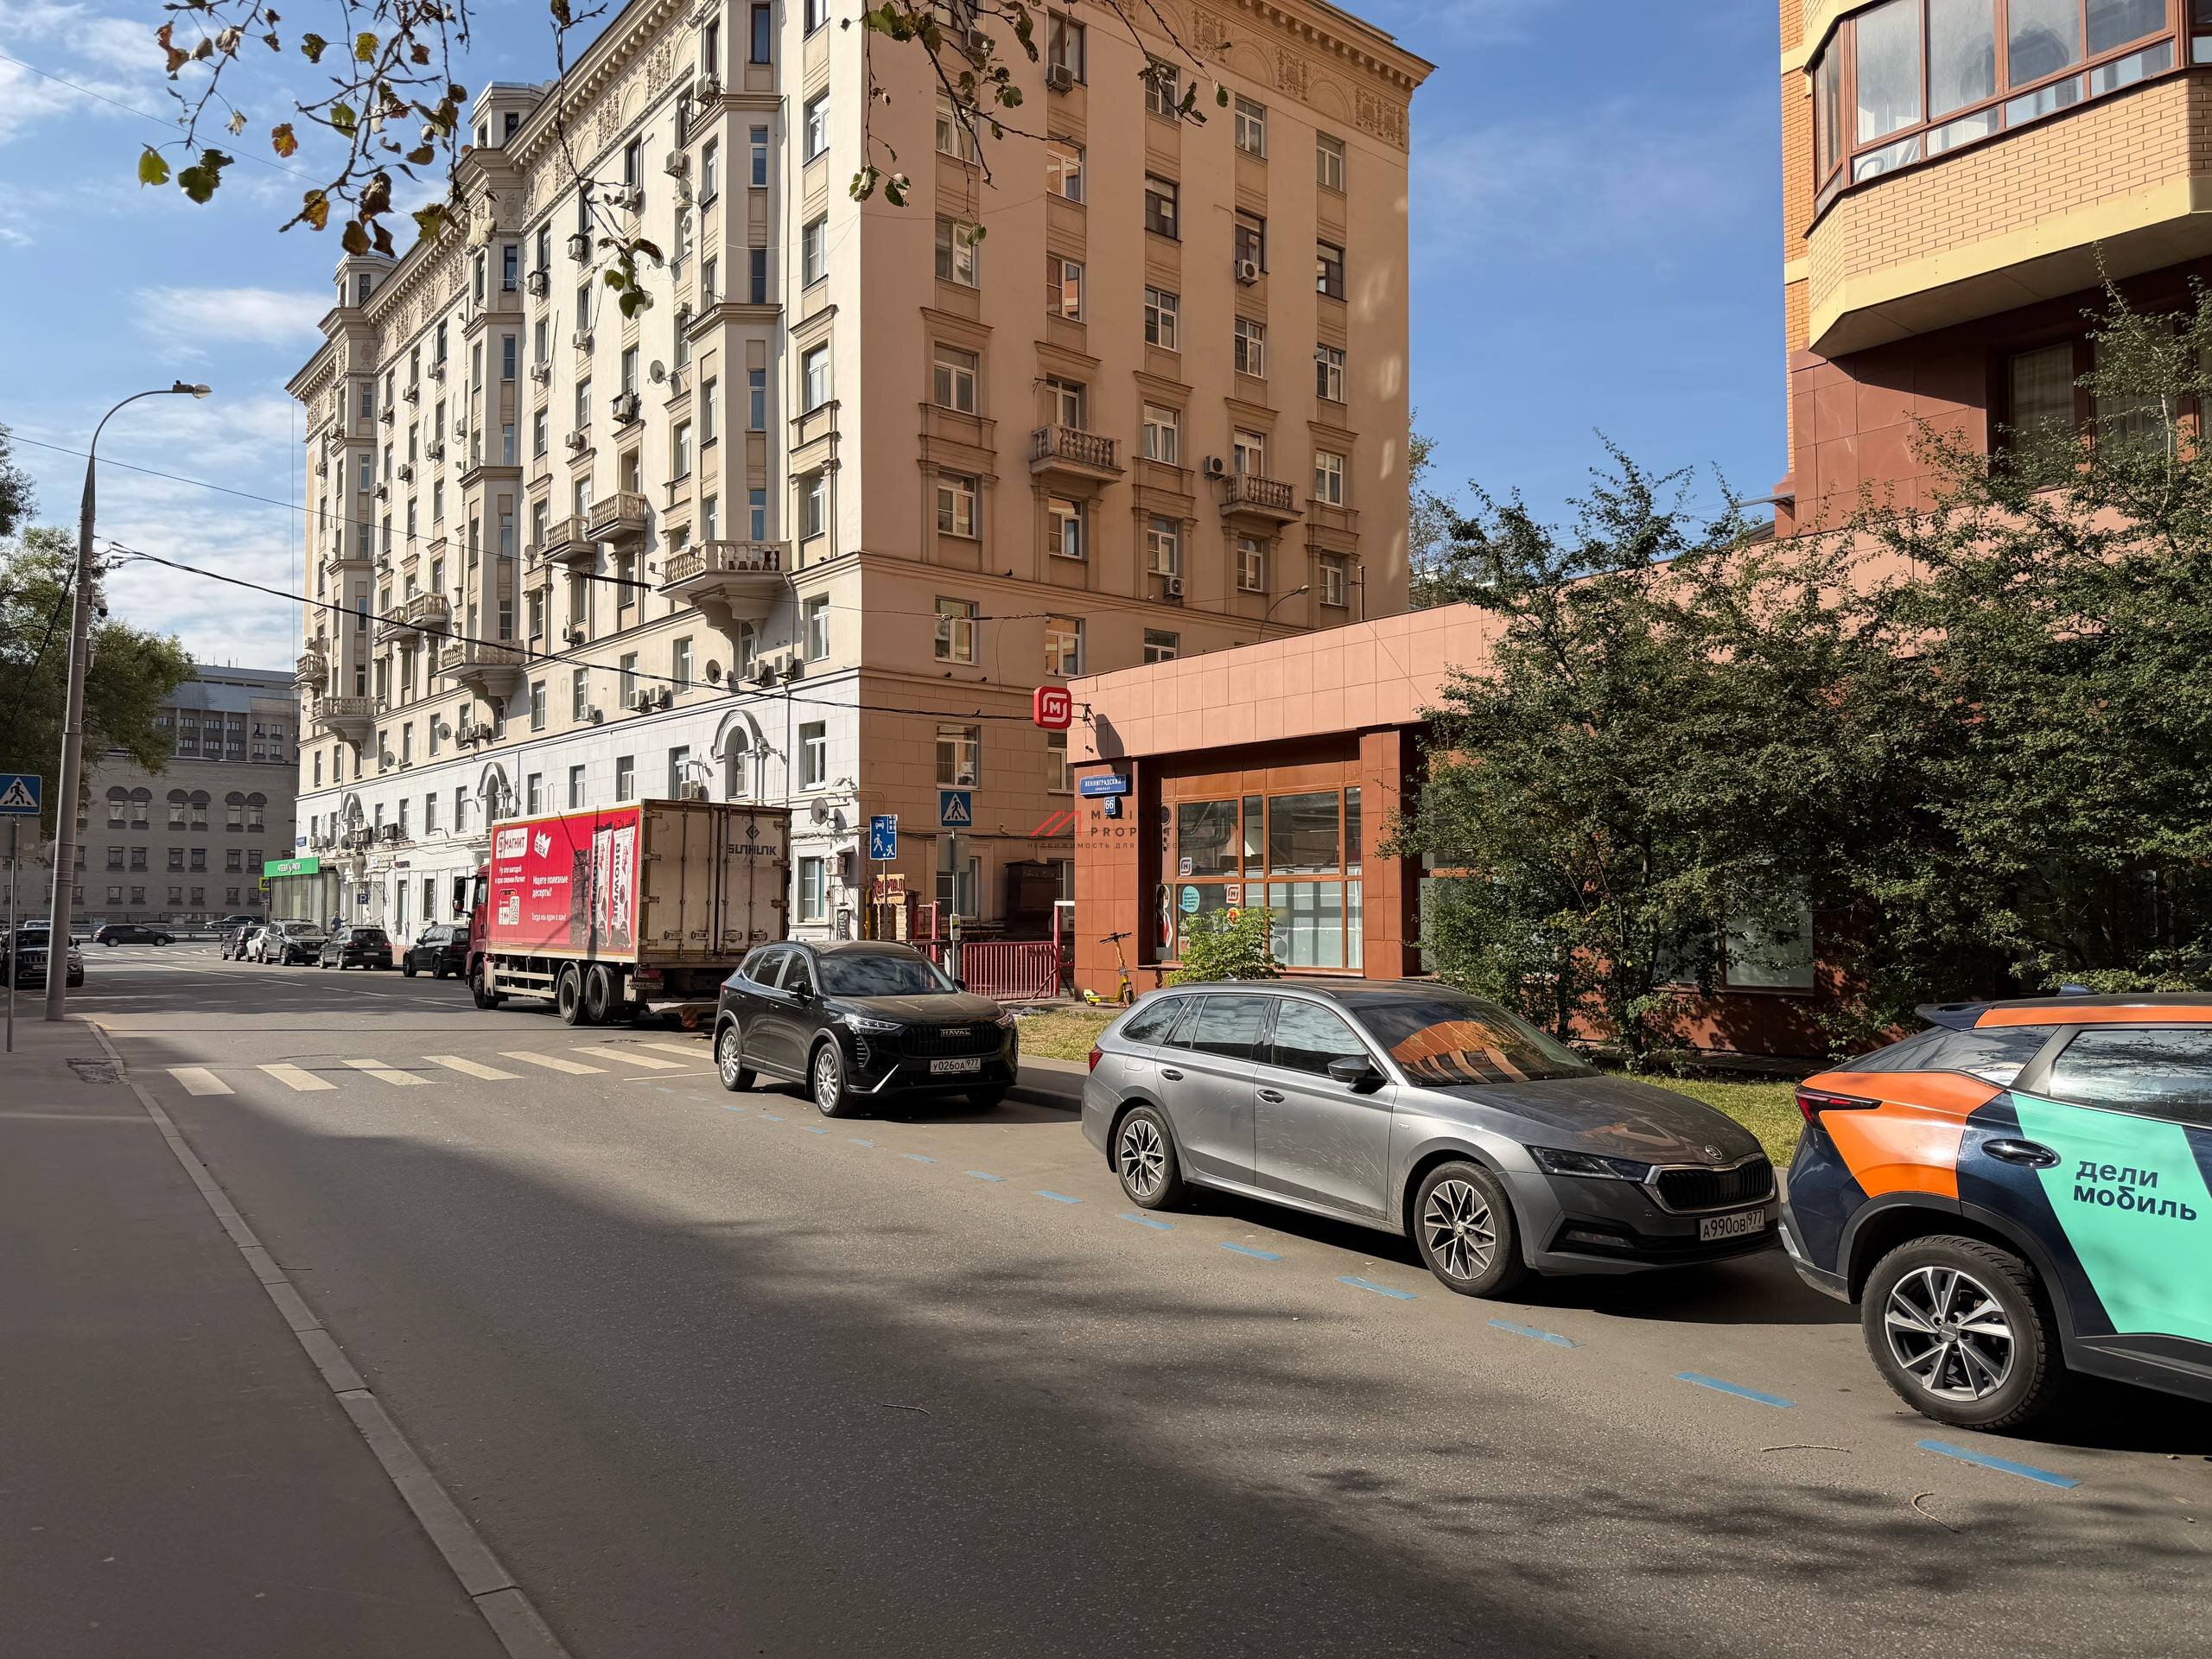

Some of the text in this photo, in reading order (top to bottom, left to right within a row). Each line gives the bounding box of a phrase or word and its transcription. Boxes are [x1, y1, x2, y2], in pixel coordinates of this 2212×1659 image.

[1084, 779, 1122, 787] ЛЕНИНГРАДСКИЙ
[1105, 799, 1115, 810] 66
[505, 836, 526, 850] МАГНИТ
[547, 875, 569, 884] полезные
[966, 1058, 979, 1067] 977
[2075, 1160, 2158, 1188] дели
[2073, 1185, 2197, 1221] мобиль
[1703, 1211, 1762, 1238] А990ОВ 977
